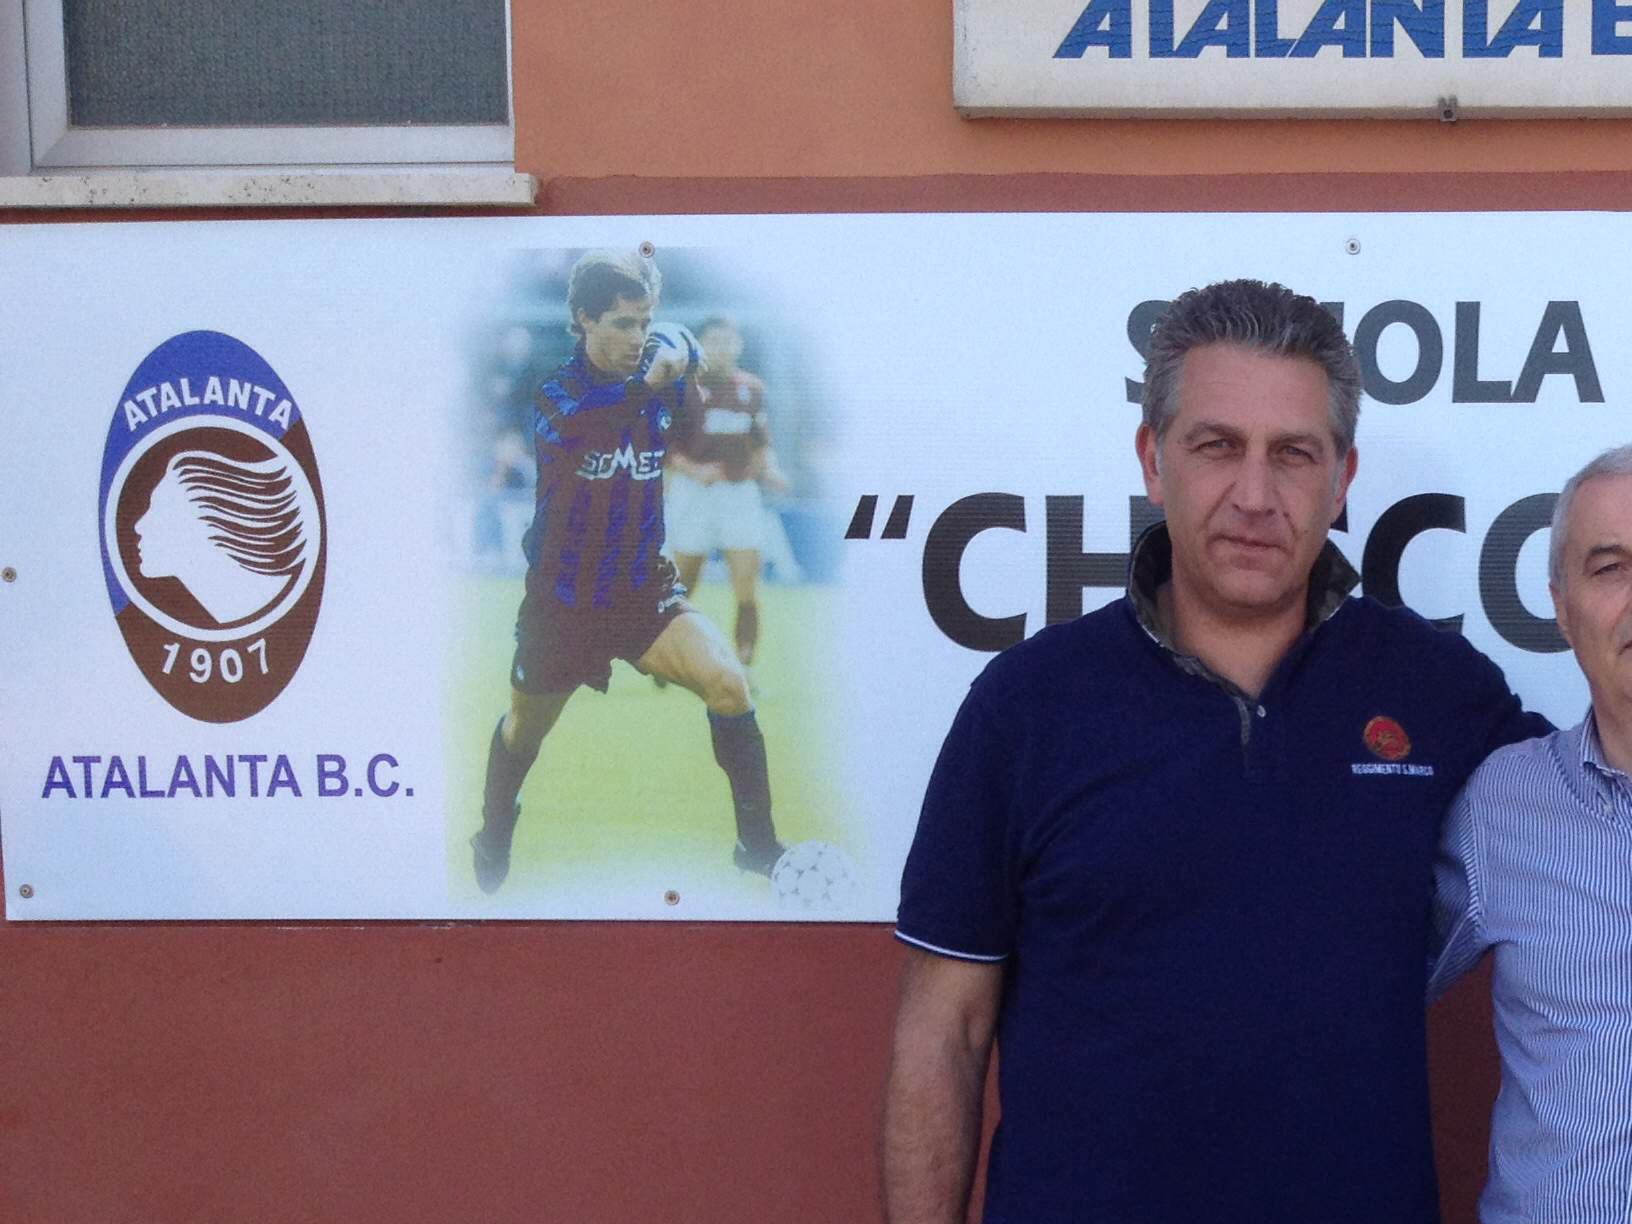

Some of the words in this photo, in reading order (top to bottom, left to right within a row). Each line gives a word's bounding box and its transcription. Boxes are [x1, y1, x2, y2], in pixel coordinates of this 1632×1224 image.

[123, 376, 293, 432] ATALANTA
[162, 637, 269, 684] 1907
[41, 754, 303, 799] ATALANTA
[316, 752, 415, 798] B.C.
